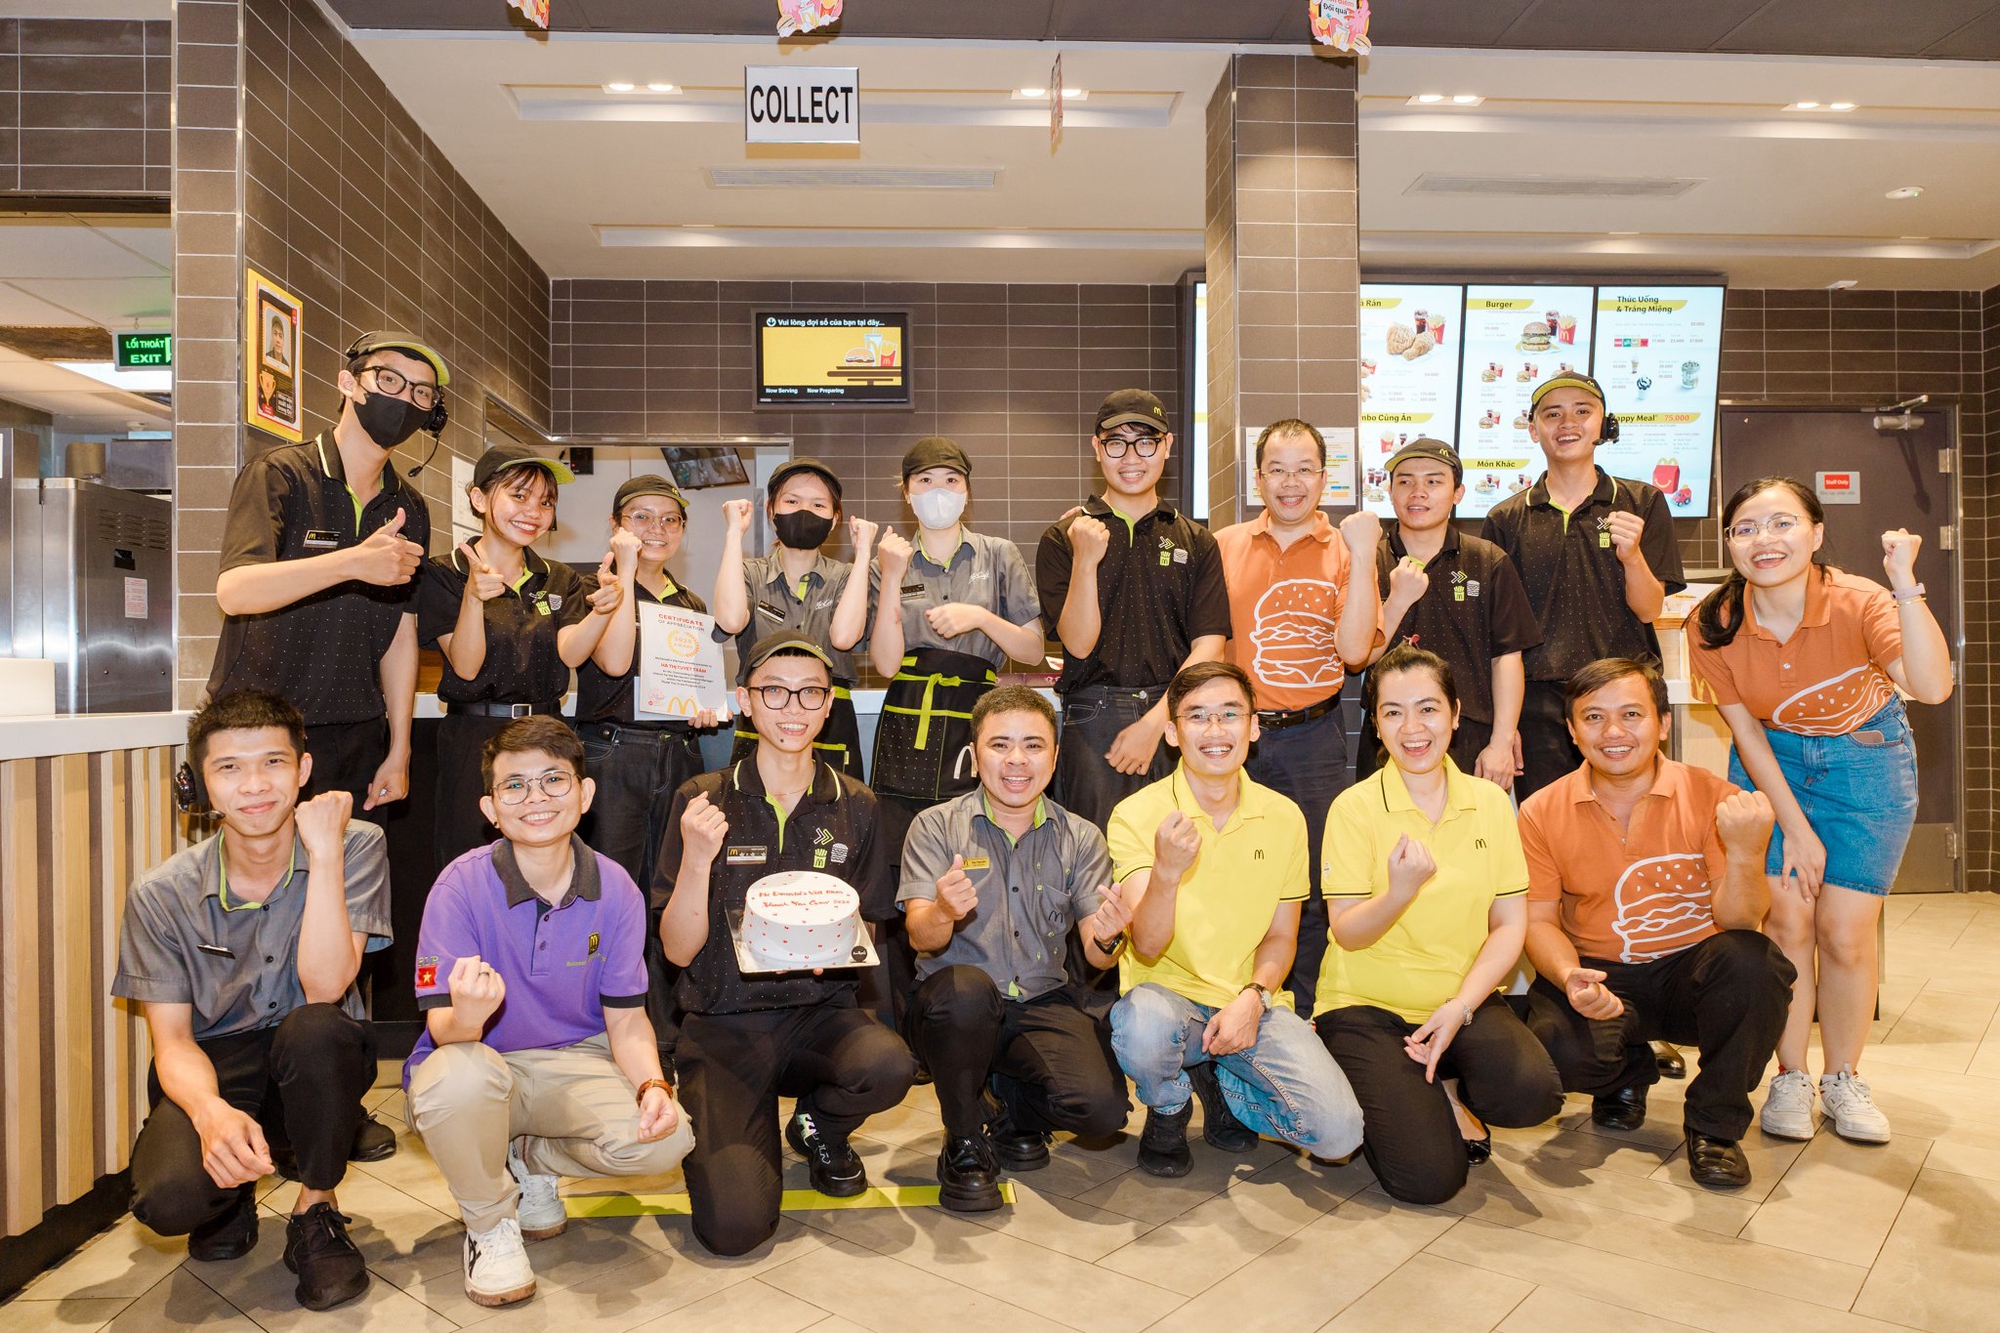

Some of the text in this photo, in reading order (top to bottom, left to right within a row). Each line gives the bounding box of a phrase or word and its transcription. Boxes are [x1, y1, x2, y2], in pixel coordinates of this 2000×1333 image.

[750, 84, 853, 124] COLLECT
[1638, 295, 1659, 304] Uống
[1485, 300, 1513, 309] Burger
[1624, 305, 1647, 314] Tráng
[1648, 305, 1673, 315] Miệng
[790, 318, 806, 327] lòng
[126, 337, 164, 348] LỐI THOÁT
[130, 354, 162, 363] EXIT
[1378, 414, 1400, 423] Cùng
[1400, 413, 1412, 421] Ăn
[1616, 415, 1635, 423] appy
[1477, 459, 1516, 467] Món Khác
[658, 613, 704, 627] CERTIFICATE
